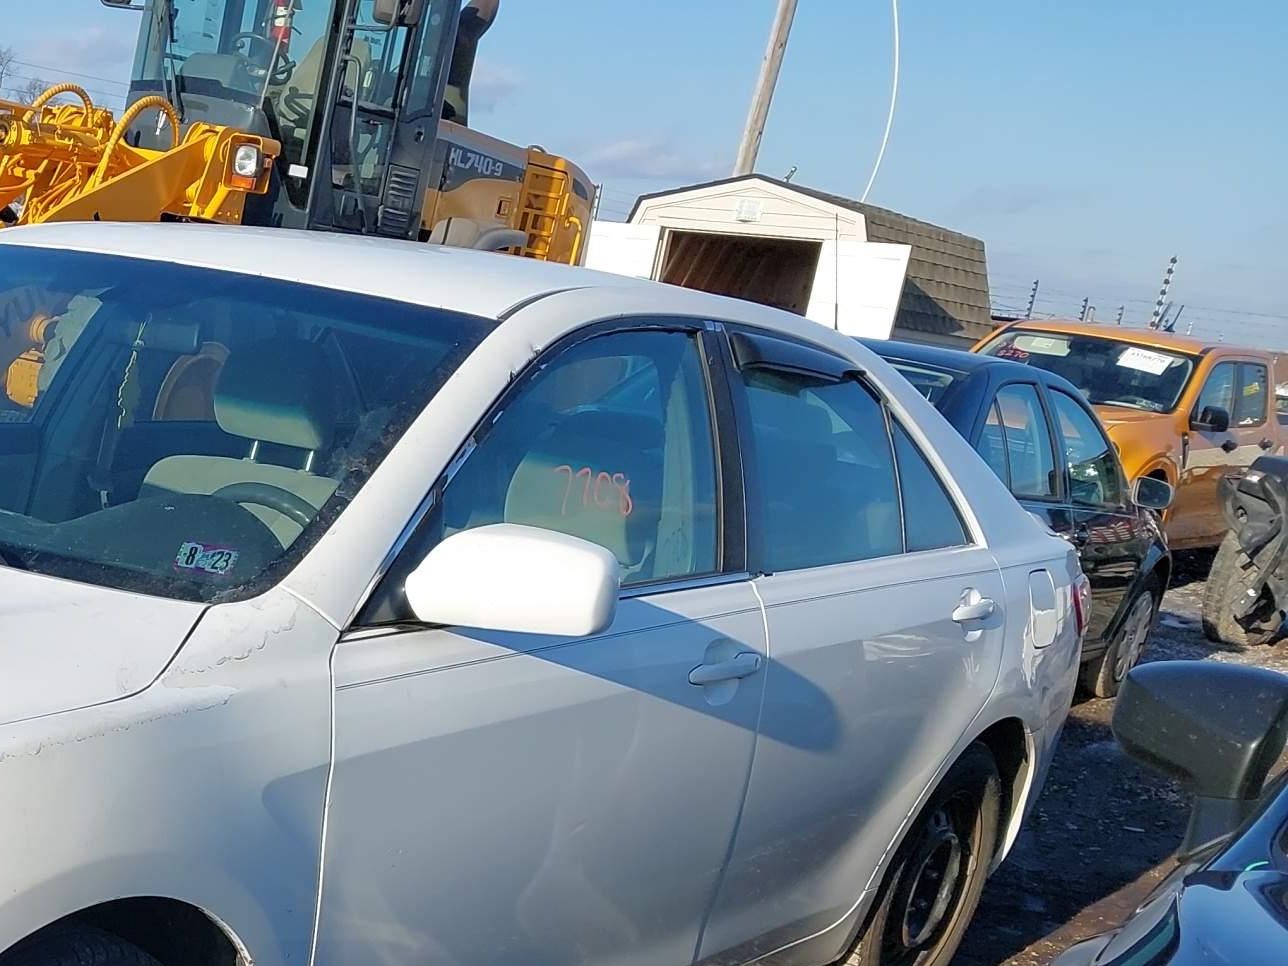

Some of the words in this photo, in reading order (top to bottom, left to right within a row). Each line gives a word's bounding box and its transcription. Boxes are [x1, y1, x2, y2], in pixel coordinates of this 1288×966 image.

[448, 147, 504, 177] HL740-9
[553, 464, 633, 518] 7708
[184, 546, 199, 566] 8
[211, 551, 232, 570] 23
